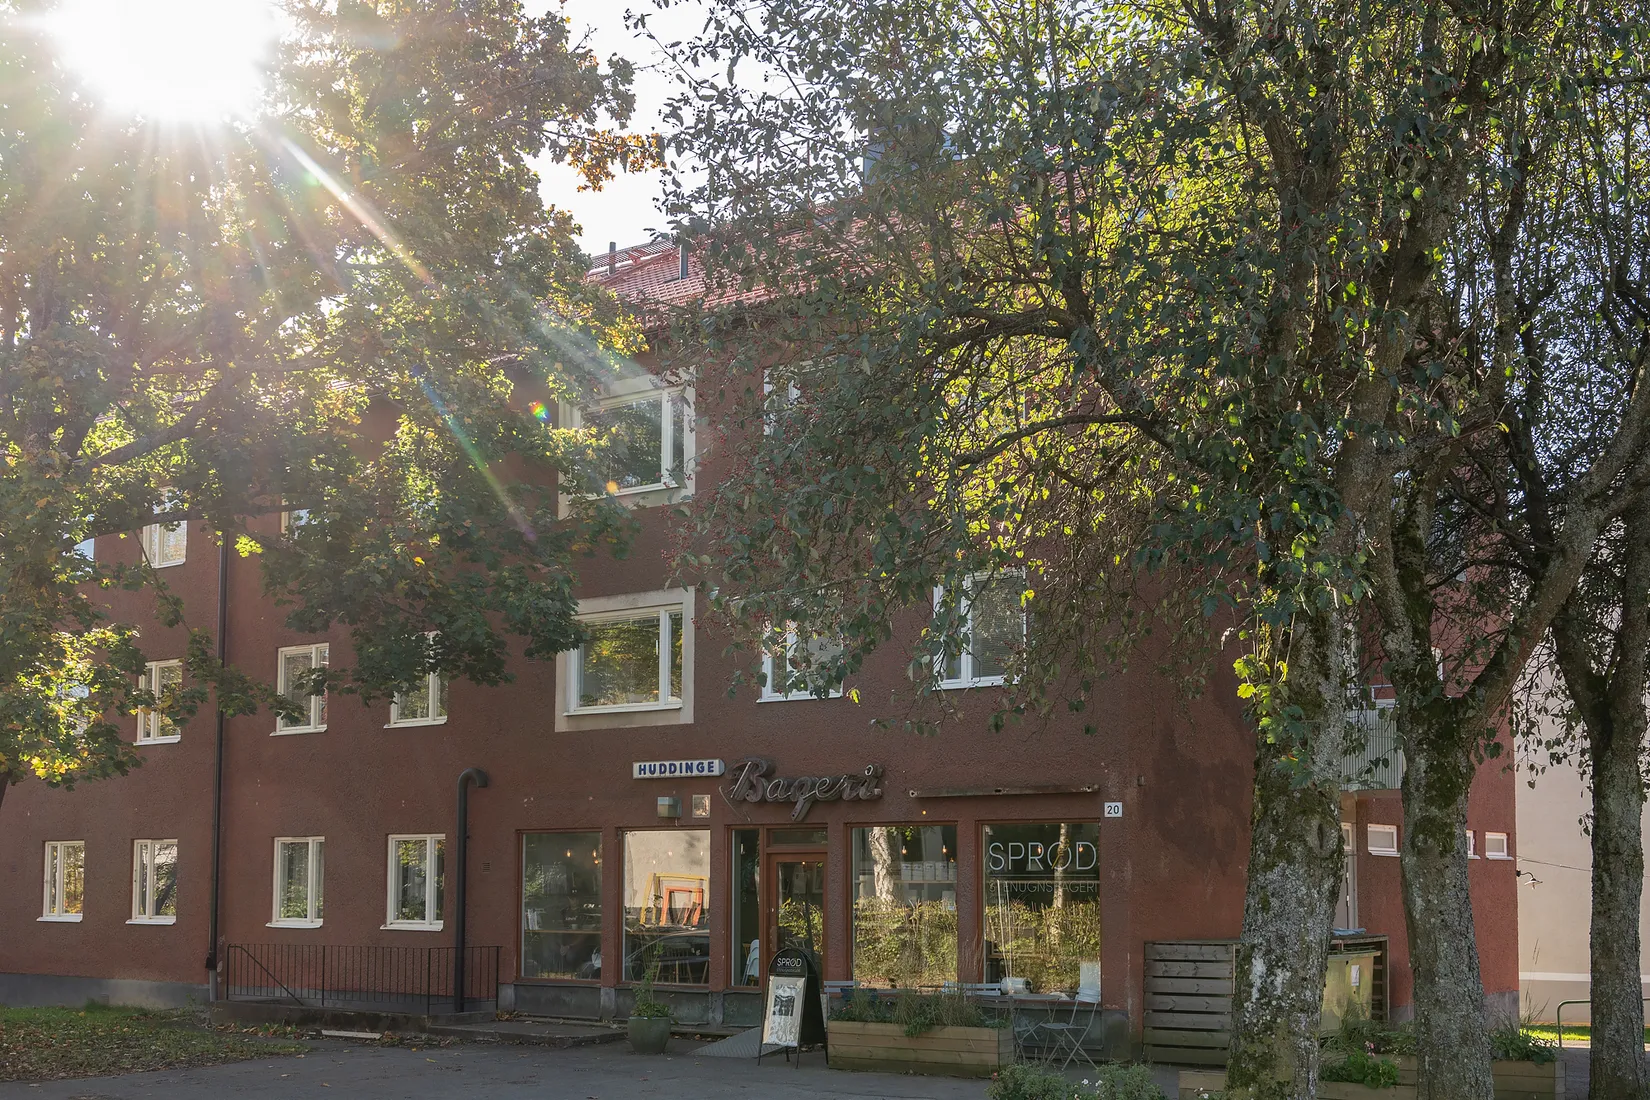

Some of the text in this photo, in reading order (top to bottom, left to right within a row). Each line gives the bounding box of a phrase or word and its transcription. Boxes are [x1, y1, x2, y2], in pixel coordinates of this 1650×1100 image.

[638, 761, 714, 776] HUDDINGE
[727, 757, 883, 822] Bageri
[1107, 805, 1120, 815] 20
[989, 841, 1097, 871] SPRØD
[989, 880, 1098, 893] SENUGNSAGERI
